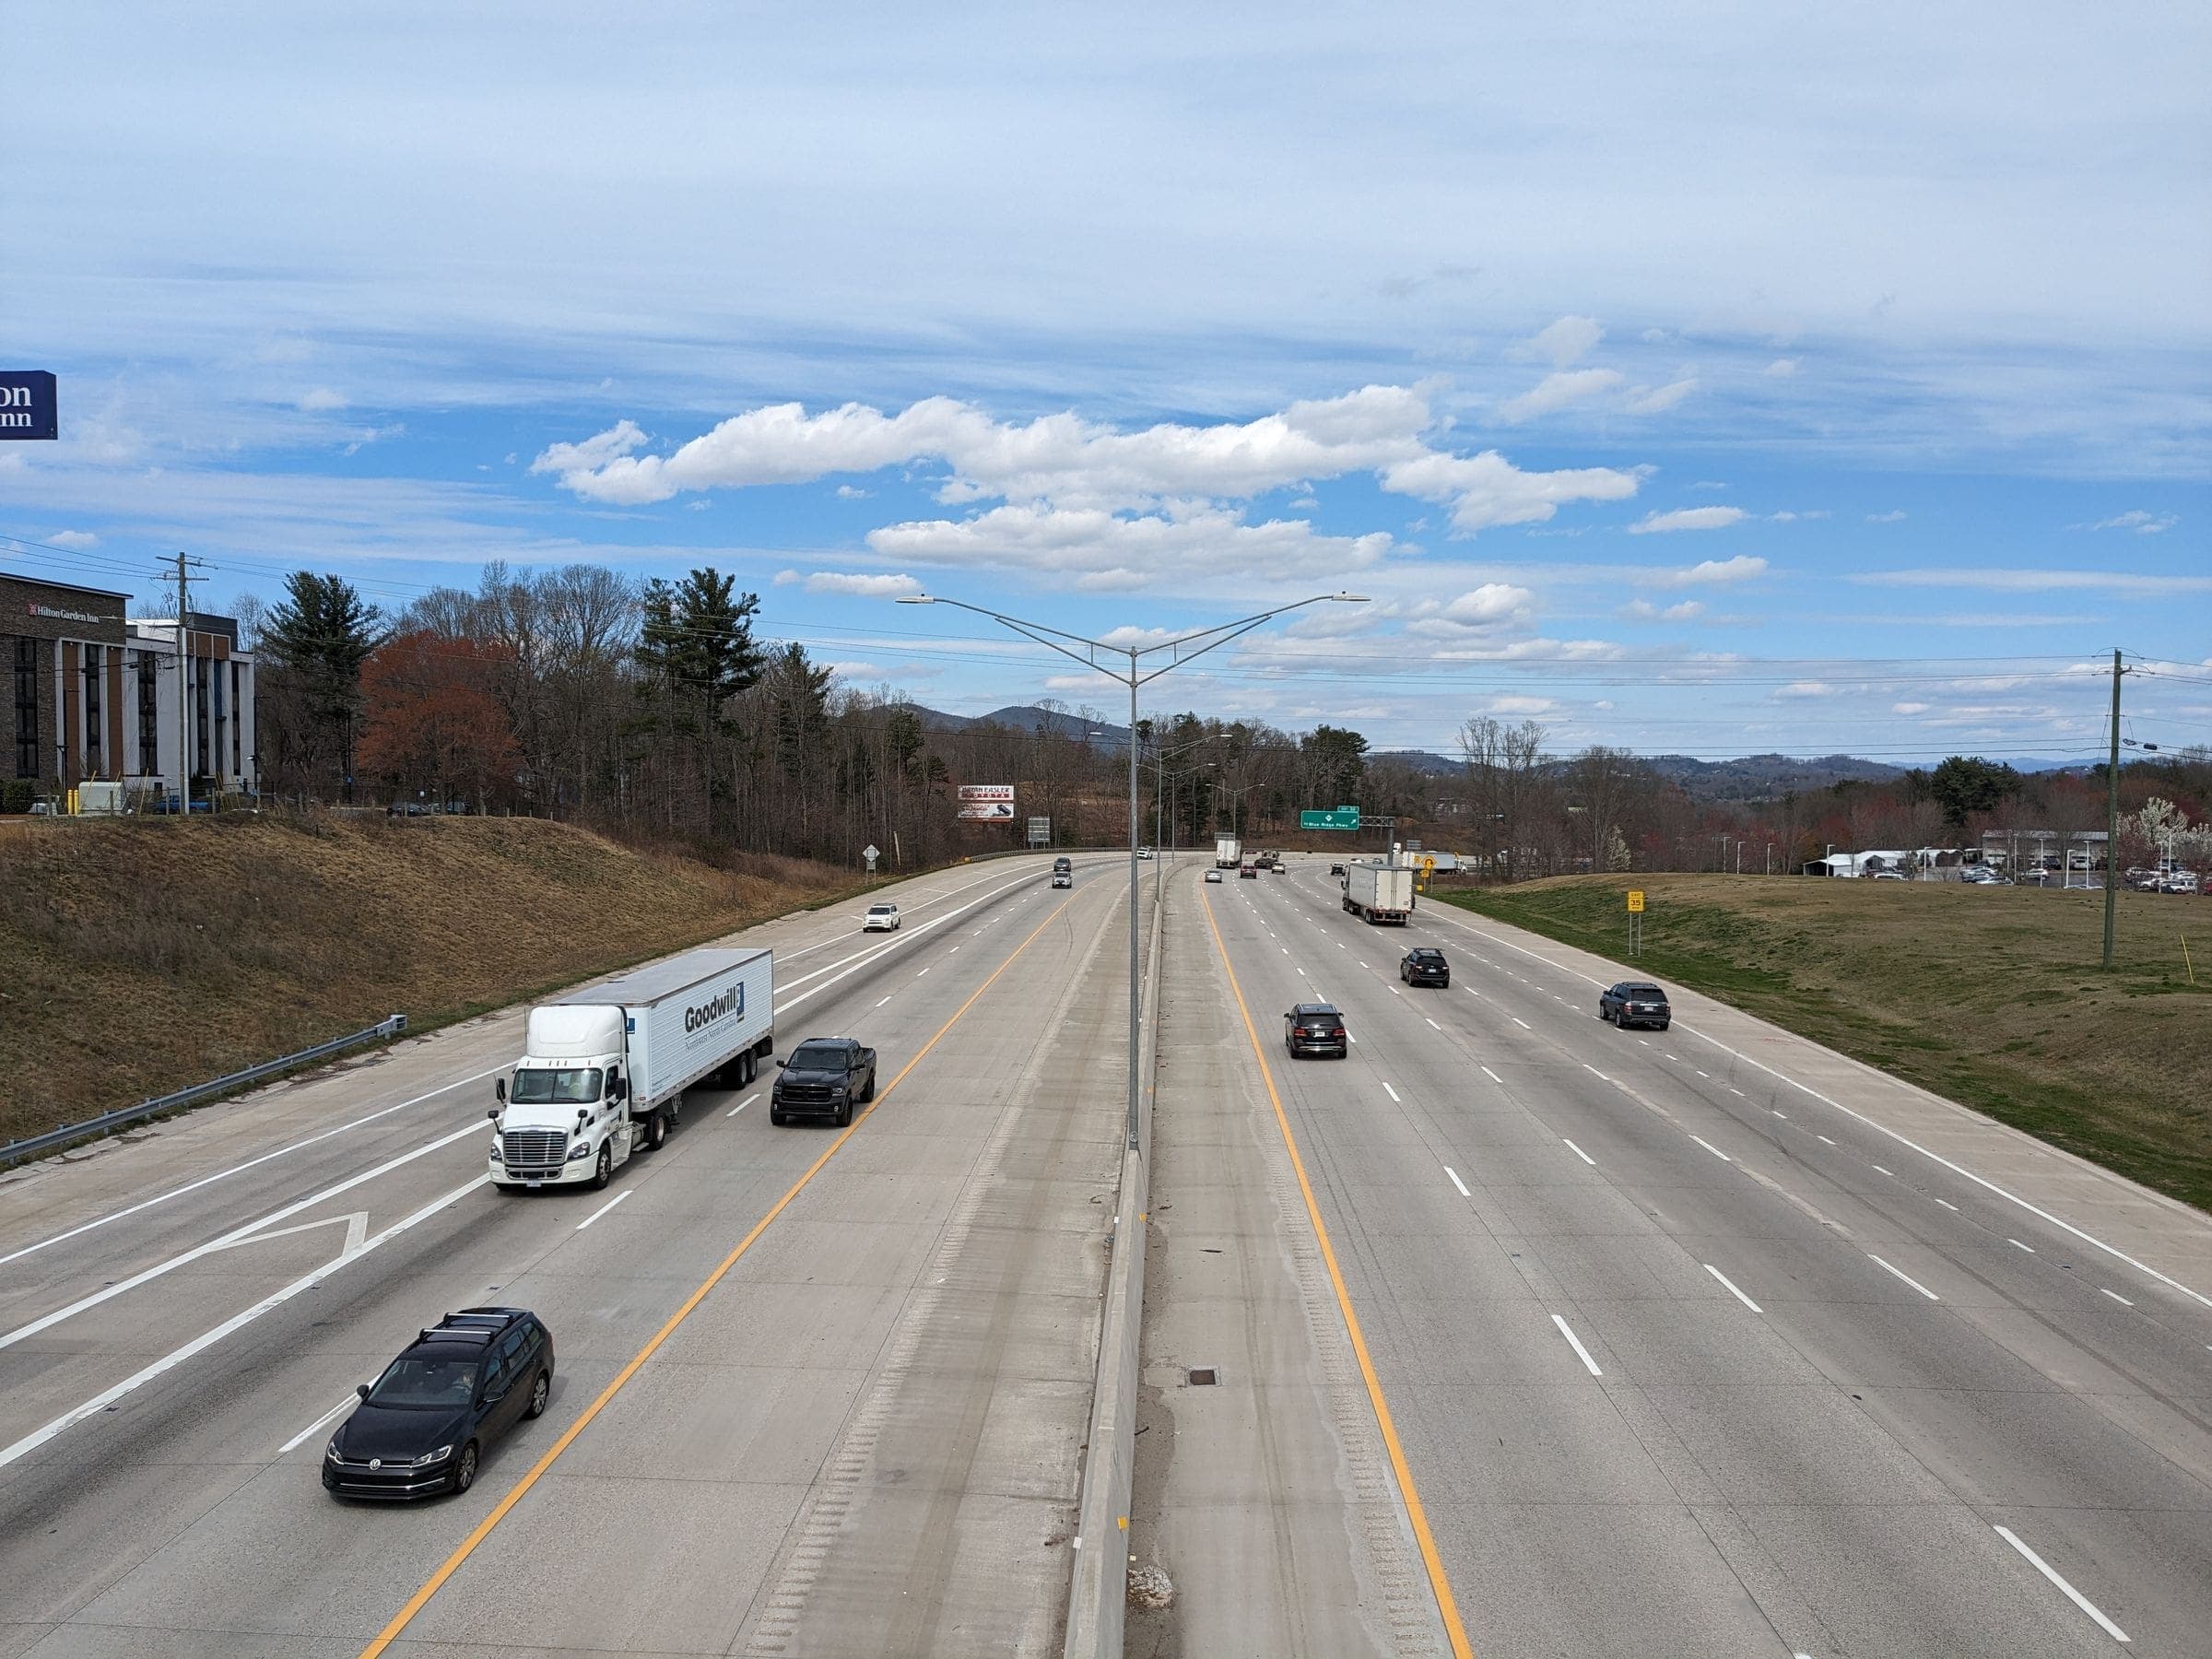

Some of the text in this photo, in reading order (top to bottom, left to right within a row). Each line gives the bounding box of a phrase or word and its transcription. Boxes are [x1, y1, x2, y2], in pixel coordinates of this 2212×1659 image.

[38, 606, 100, 623] Hilton Garden Inn
[685, 986, 735, 1032] Goodwill
